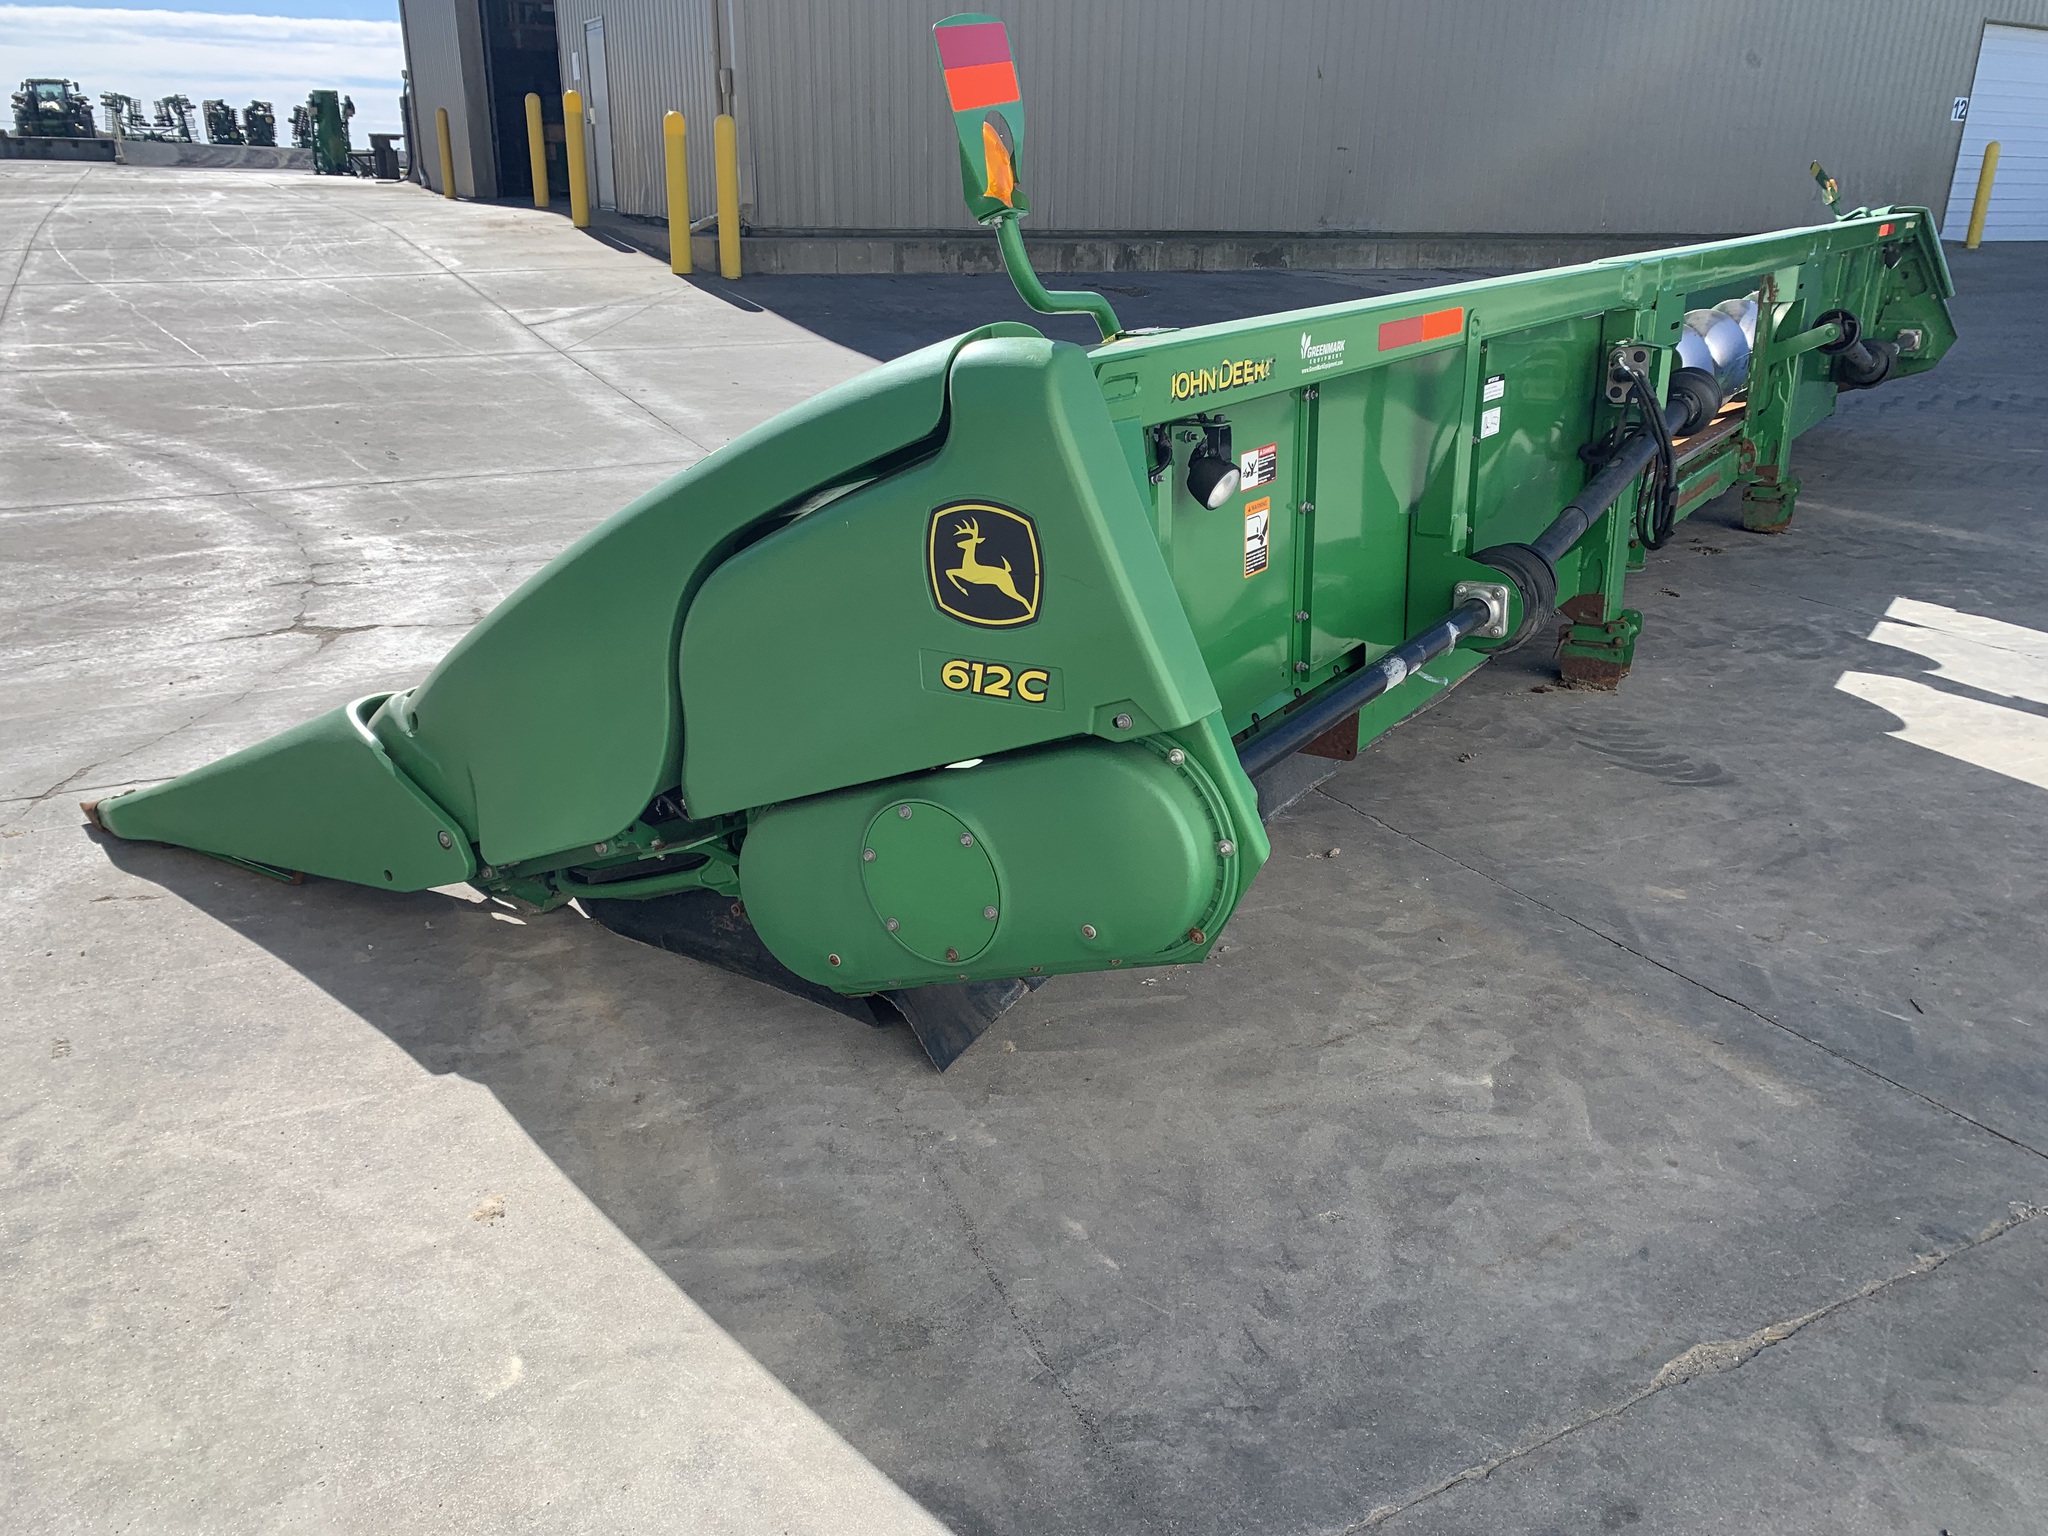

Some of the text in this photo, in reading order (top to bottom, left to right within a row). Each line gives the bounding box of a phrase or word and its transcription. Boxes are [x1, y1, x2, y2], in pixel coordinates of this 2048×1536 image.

[1953, 99, 1968, 120] 12
[1306, 339, 1346, 359] GREENMARK
[1309, 352, 1342, 365] EQUIPMENT
[1169, 366, 1218, 402] JOHN
[940, 658, 1051, 703] 612C
